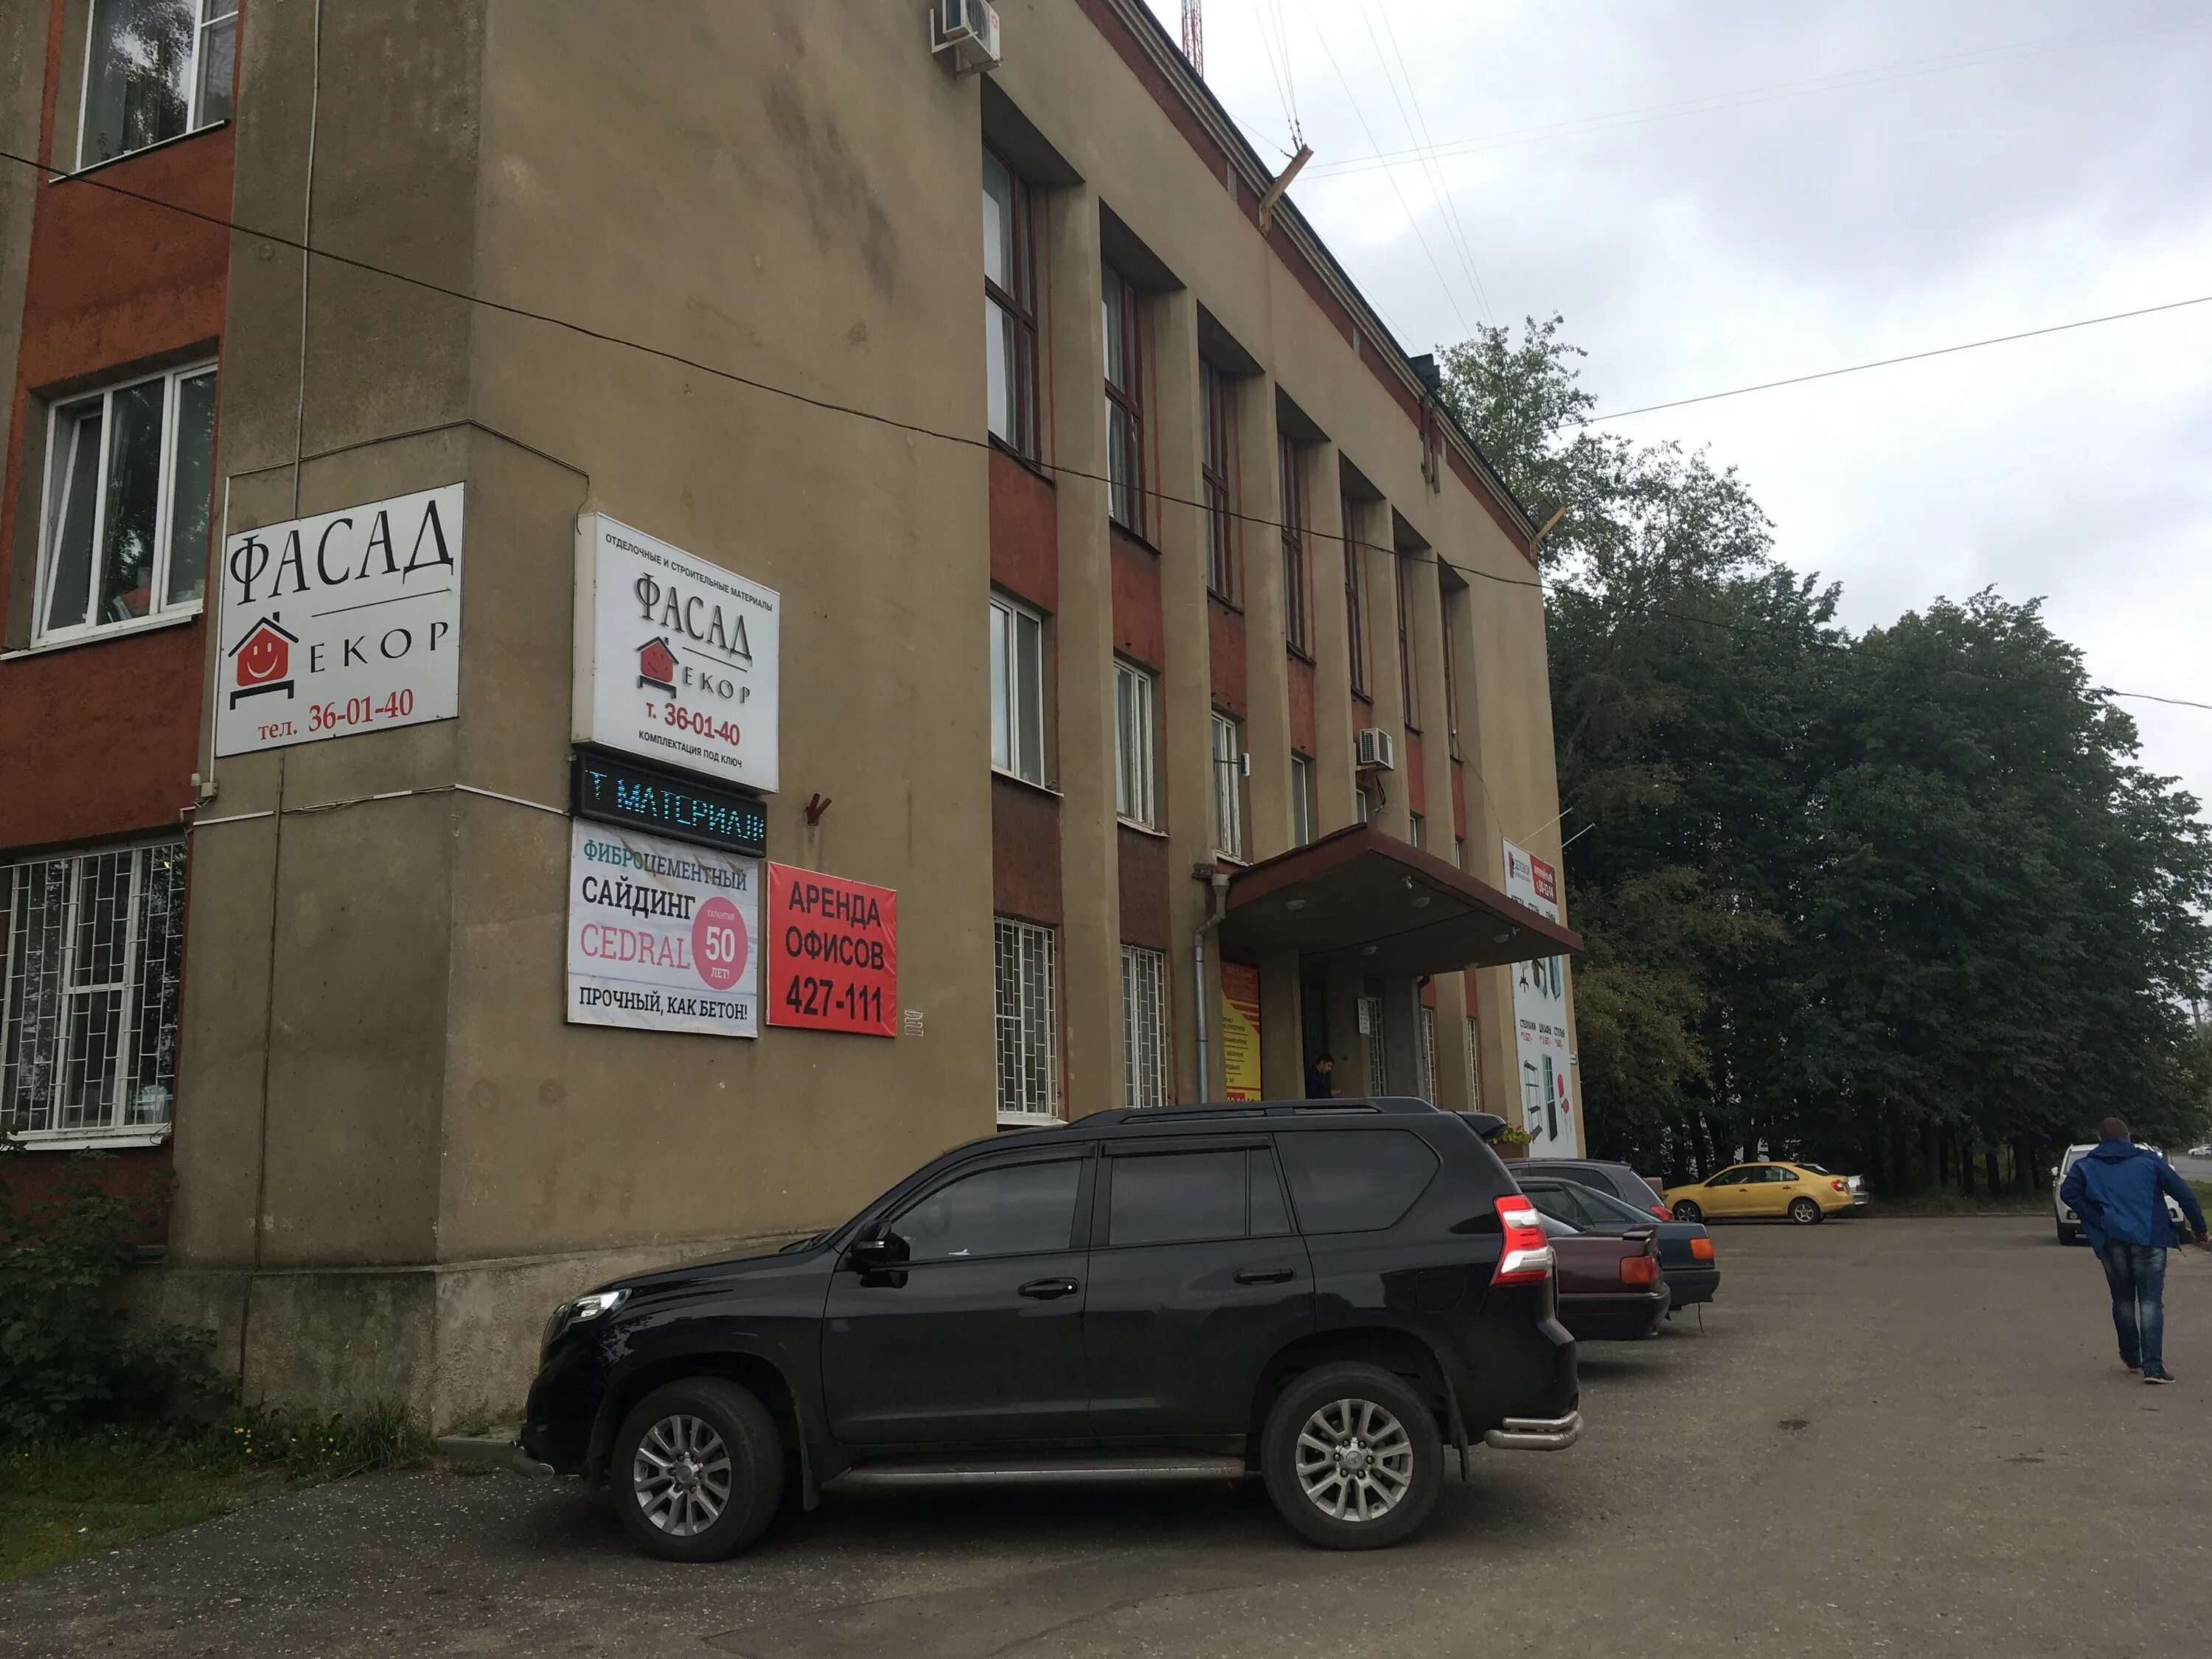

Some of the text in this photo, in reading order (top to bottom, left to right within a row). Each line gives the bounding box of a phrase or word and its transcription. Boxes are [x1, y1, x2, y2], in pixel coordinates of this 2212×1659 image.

[229, 499, 454, 606] ФАСАД
[605, 533, 773, 612] ОТДЕЛОЧНЫЕ И СТРОИТЕЛЬНЫЕ МАТЕРИАЛЫ
[634, 571, 753, 667] ФАСАД
[257, 688, 414, 740] тел. 36-01-40
[646, 702, 740, 747] т. 36-01-40
[639, 730, 742, 768] КОМПЛЕКТАЦИЯ ПОД КЛЮЧ
[590, 771, 608, 800] Т
[583, 839, 747, 891] ФИБРОЦЕМЕНТНЫЙ
[582, 875, 695, 920] САЙДИНГ
[789, 881, 882, 931] АРЕНДА
[580, 922, 691, 970] CEDRAL
[706, 925, 736, 963] 50
[785, 926, 885, 970] ОФИСОВ
[711, 967, 730, 979] ЛЕТ!
[579, 986, 748, 1020] ПРОЧНЫЙ, КАК БЕТОН!
[786, 975, 882, 1023] 427-111
